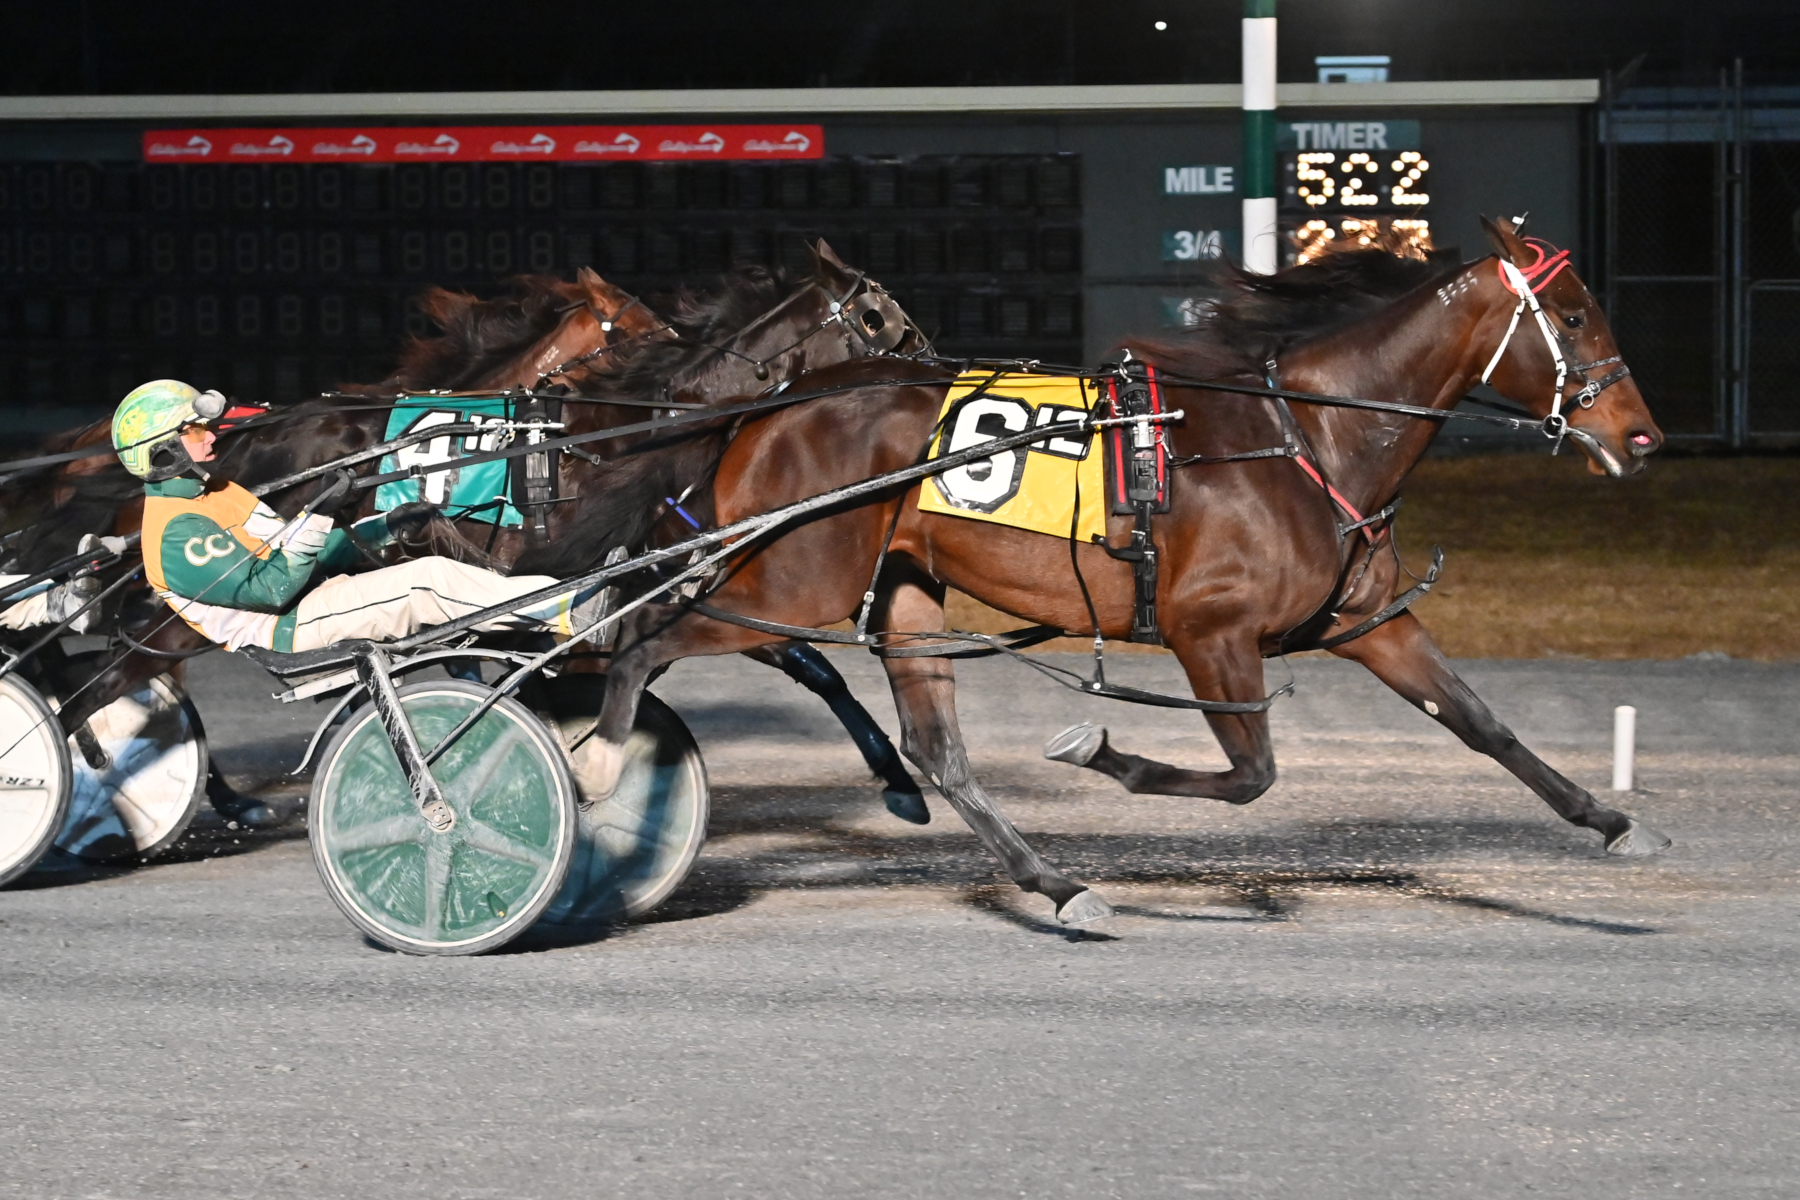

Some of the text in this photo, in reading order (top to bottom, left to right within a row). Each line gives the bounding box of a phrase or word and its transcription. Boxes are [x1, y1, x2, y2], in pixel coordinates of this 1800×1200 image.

[1292, 122, 1388, 149] TIMER
[1165, 167, 1234, 193] MILE
[1174, 230, 1223, 259] 3/4
[397, 411, 457, 505] 4
[942, 397, 1029, 504] 6
